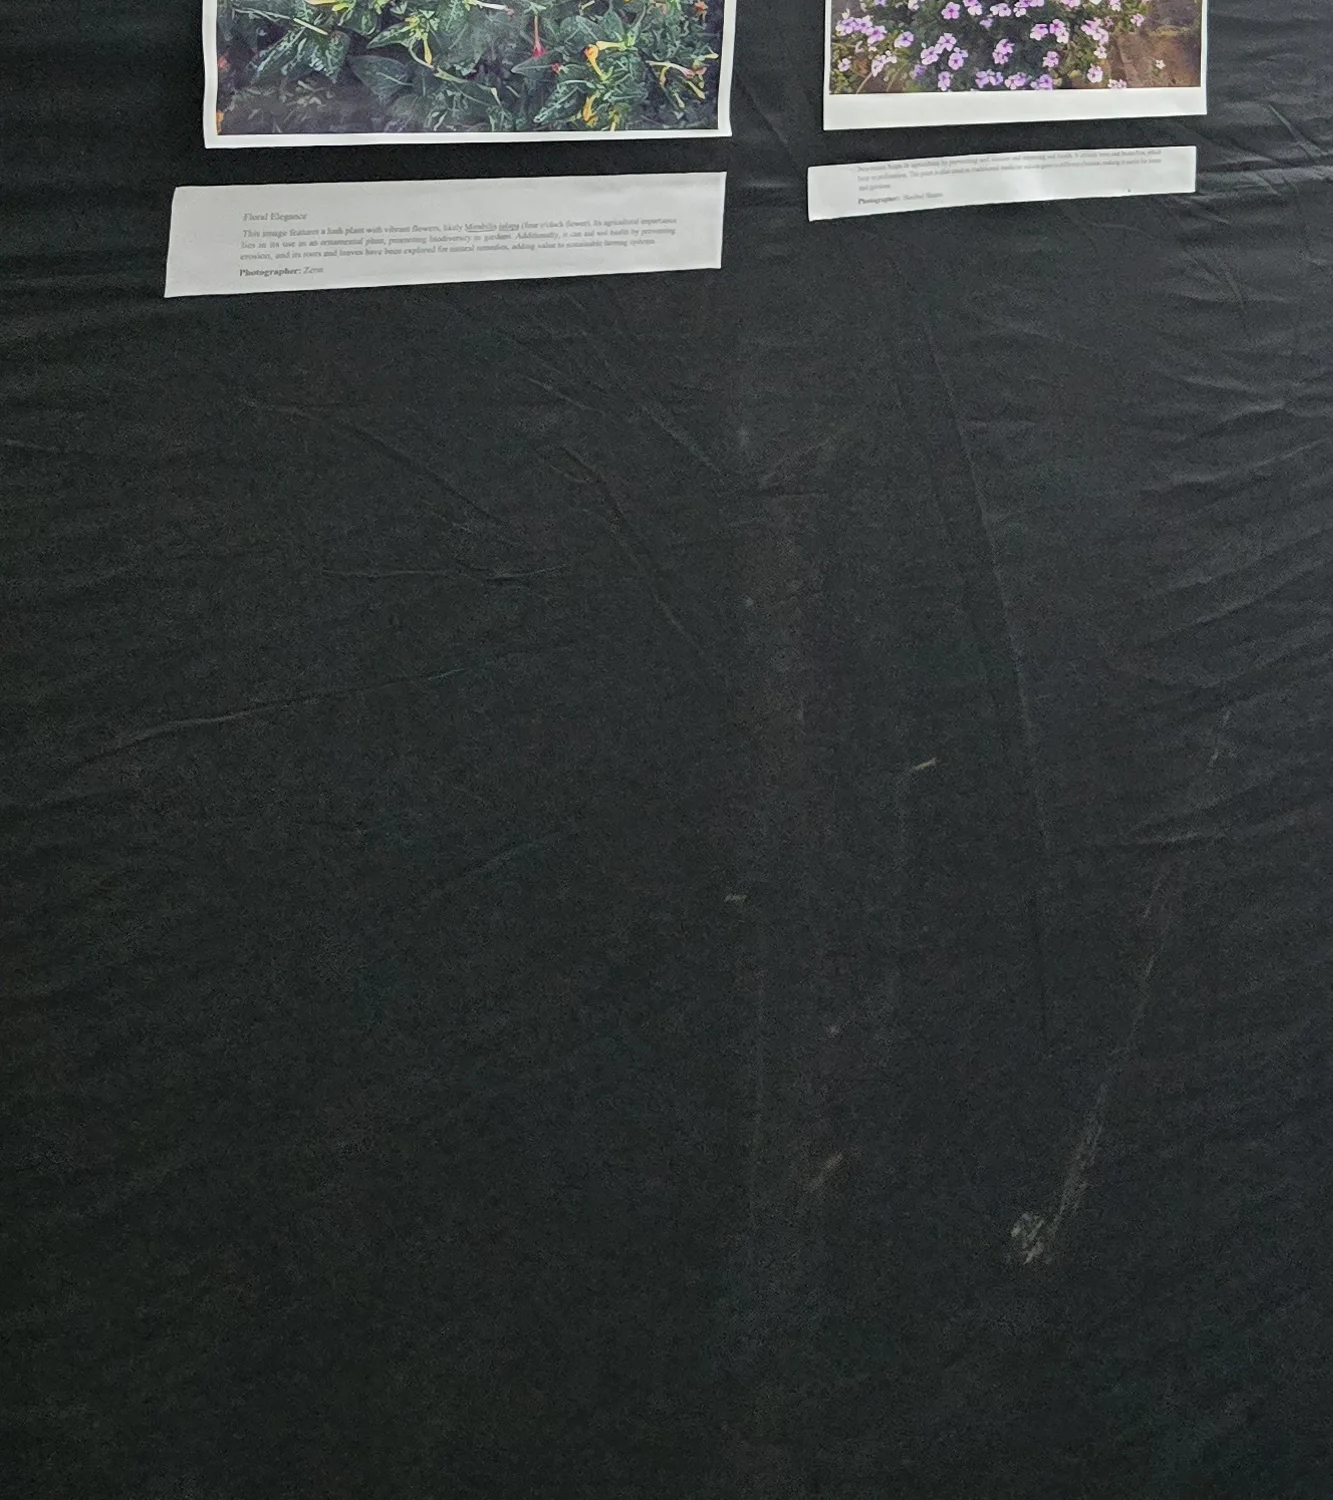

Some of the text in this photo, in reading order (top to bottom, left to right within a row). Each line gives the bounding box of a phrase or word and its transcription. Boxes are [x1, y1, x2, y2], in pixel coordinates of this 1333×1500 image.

[243, 214, 308, 222] Floral Elegance
[243, 230, 260, 238] This
[263, 230, 288, 239] image
[290, 228, 319, 236] features
[327, 228, 344, 236] lush
[345, 228, 365, 236] plant
[366, 226, 383, 234] with
[443, 224, 463, 233] likely
[275, 252, 290, 260] and
[324, 250, 338, 258] and
[403, 246, 436, 256] explored
[239, 268, 302, 278] Photographer:
